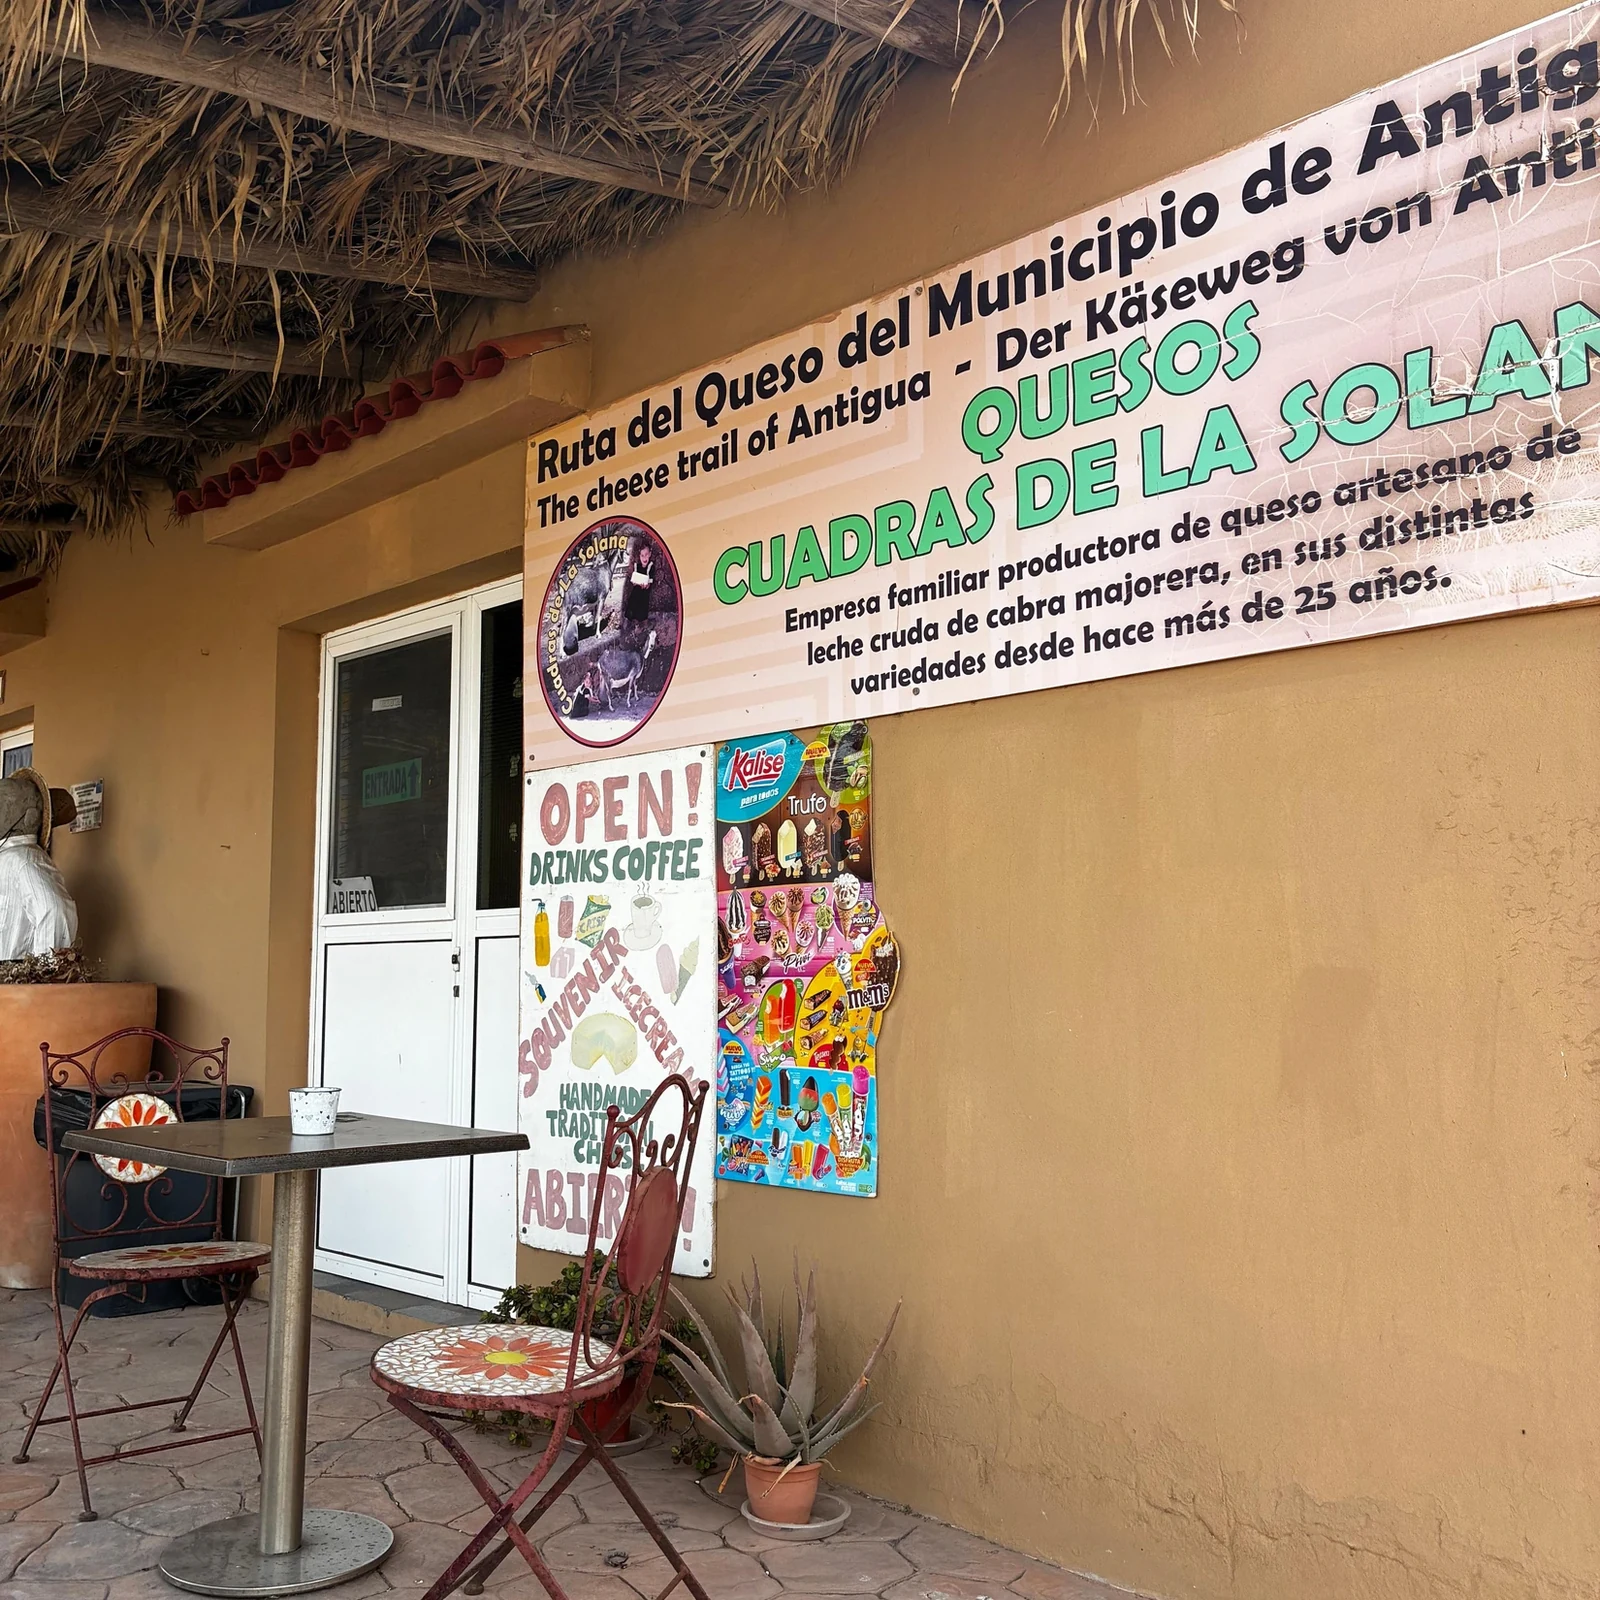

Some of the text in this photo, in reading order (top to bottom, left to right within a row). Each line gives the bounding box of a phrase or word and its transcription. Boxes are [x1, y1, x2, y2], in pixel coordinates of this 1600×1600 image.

[537, 425, 616, 484] Ruta
[627, 386, 682, 448] del
[695, 345, 824, 427] Queso
[838, 295, 911, 368] del
[928, 190, 1220, 338] Municipio
[1242, 141, 1332, 214] de
[537, 495, 580, 528] The
[586, 462, 670, 513] cheese
[677, 428, 738, 482] trail
[748, 412, 779, 457] of
[787, 370, 931, 444] Antigua
[997, 320, 1072, 373] Der
[1086, 237, 1304, 342] Käseweg
[1323, 191, 1432, 256] von
[961, 299, 1262, 464] QUESOS
[713, 473, 995, 606] CUADRAS
[1016, 438, 1120, 531] DE
[1140, 404, 1257, 498] LA
[785, 424, 1582, 634] Empresa familiar productora de queso artesano de
[806, 492, 1535, 667] leche cruda de cabra majorera, en sus distintas
[547, 534, 629, 716] Cuadras de La Solana
[850, 563, 1452, 696] variedades desde hace más de 25 años.
[365, 767, 408, 800] ENTRADA
[727, 748, 785, 791] Kalise
[805, 746, 827, 756] NUEVO
[540, 762, 702, 846] OPEN!
[740, 794, 758, 807] para
[787, 792, 828, 816] Trufo
[333, 889, 376, 914] ABIERTO
[529, 838, 703, 885] DRINKS COFFEE
[518, 927, 629, 1098] SOUVENIR
[546, 1108, 655, 1147] TRADITONL
[560, 1082, 653, 1115] HANDMADE
